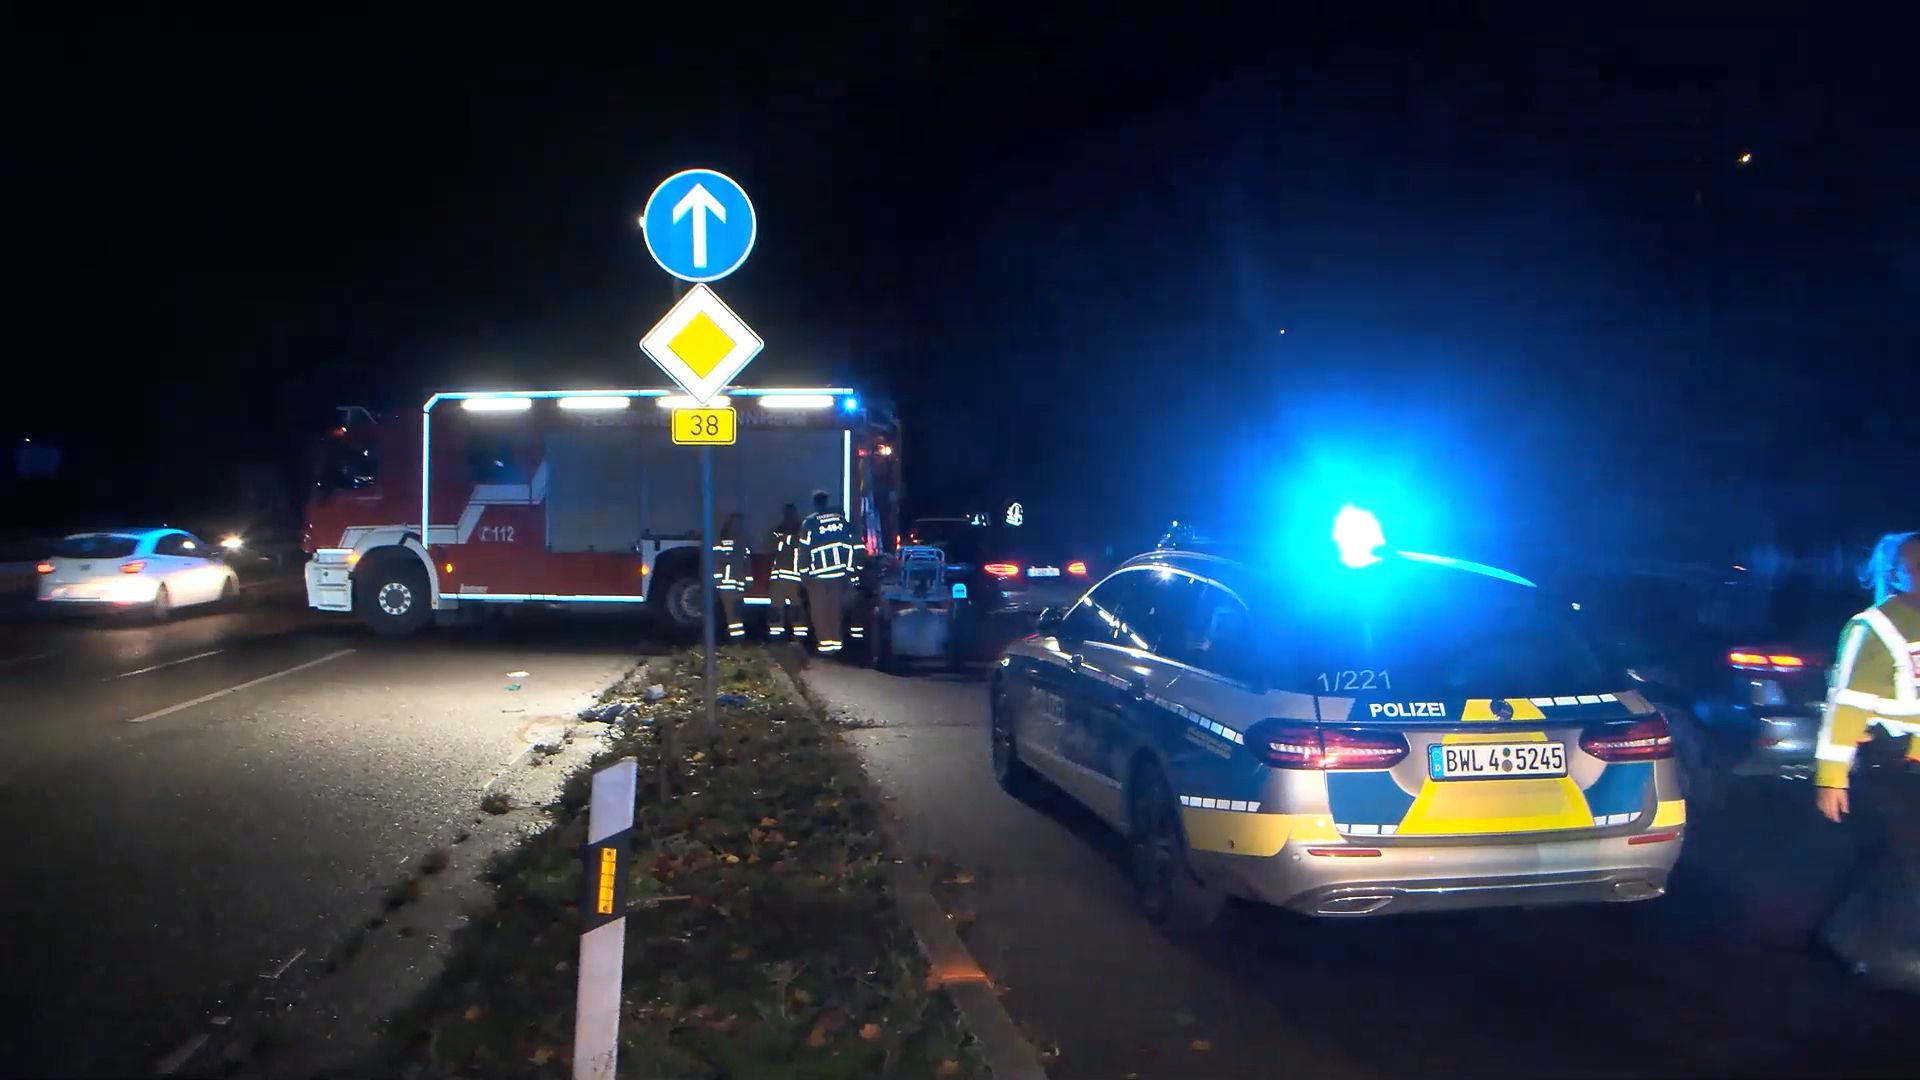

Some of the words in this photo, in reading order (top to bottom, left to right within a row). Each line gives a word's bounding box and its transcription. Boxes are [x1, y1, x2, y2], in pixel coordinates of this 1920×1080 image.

[690, 415, 719, 436] 38
[491, 526, 514, 542] 112
[1317, 669, 1391, 692] 1/221
[1369, 702, 1446, 718] POLIZEI
[1446, 749, 1483, 772] BWL
[1515, 747, 1562, 770] 5245
